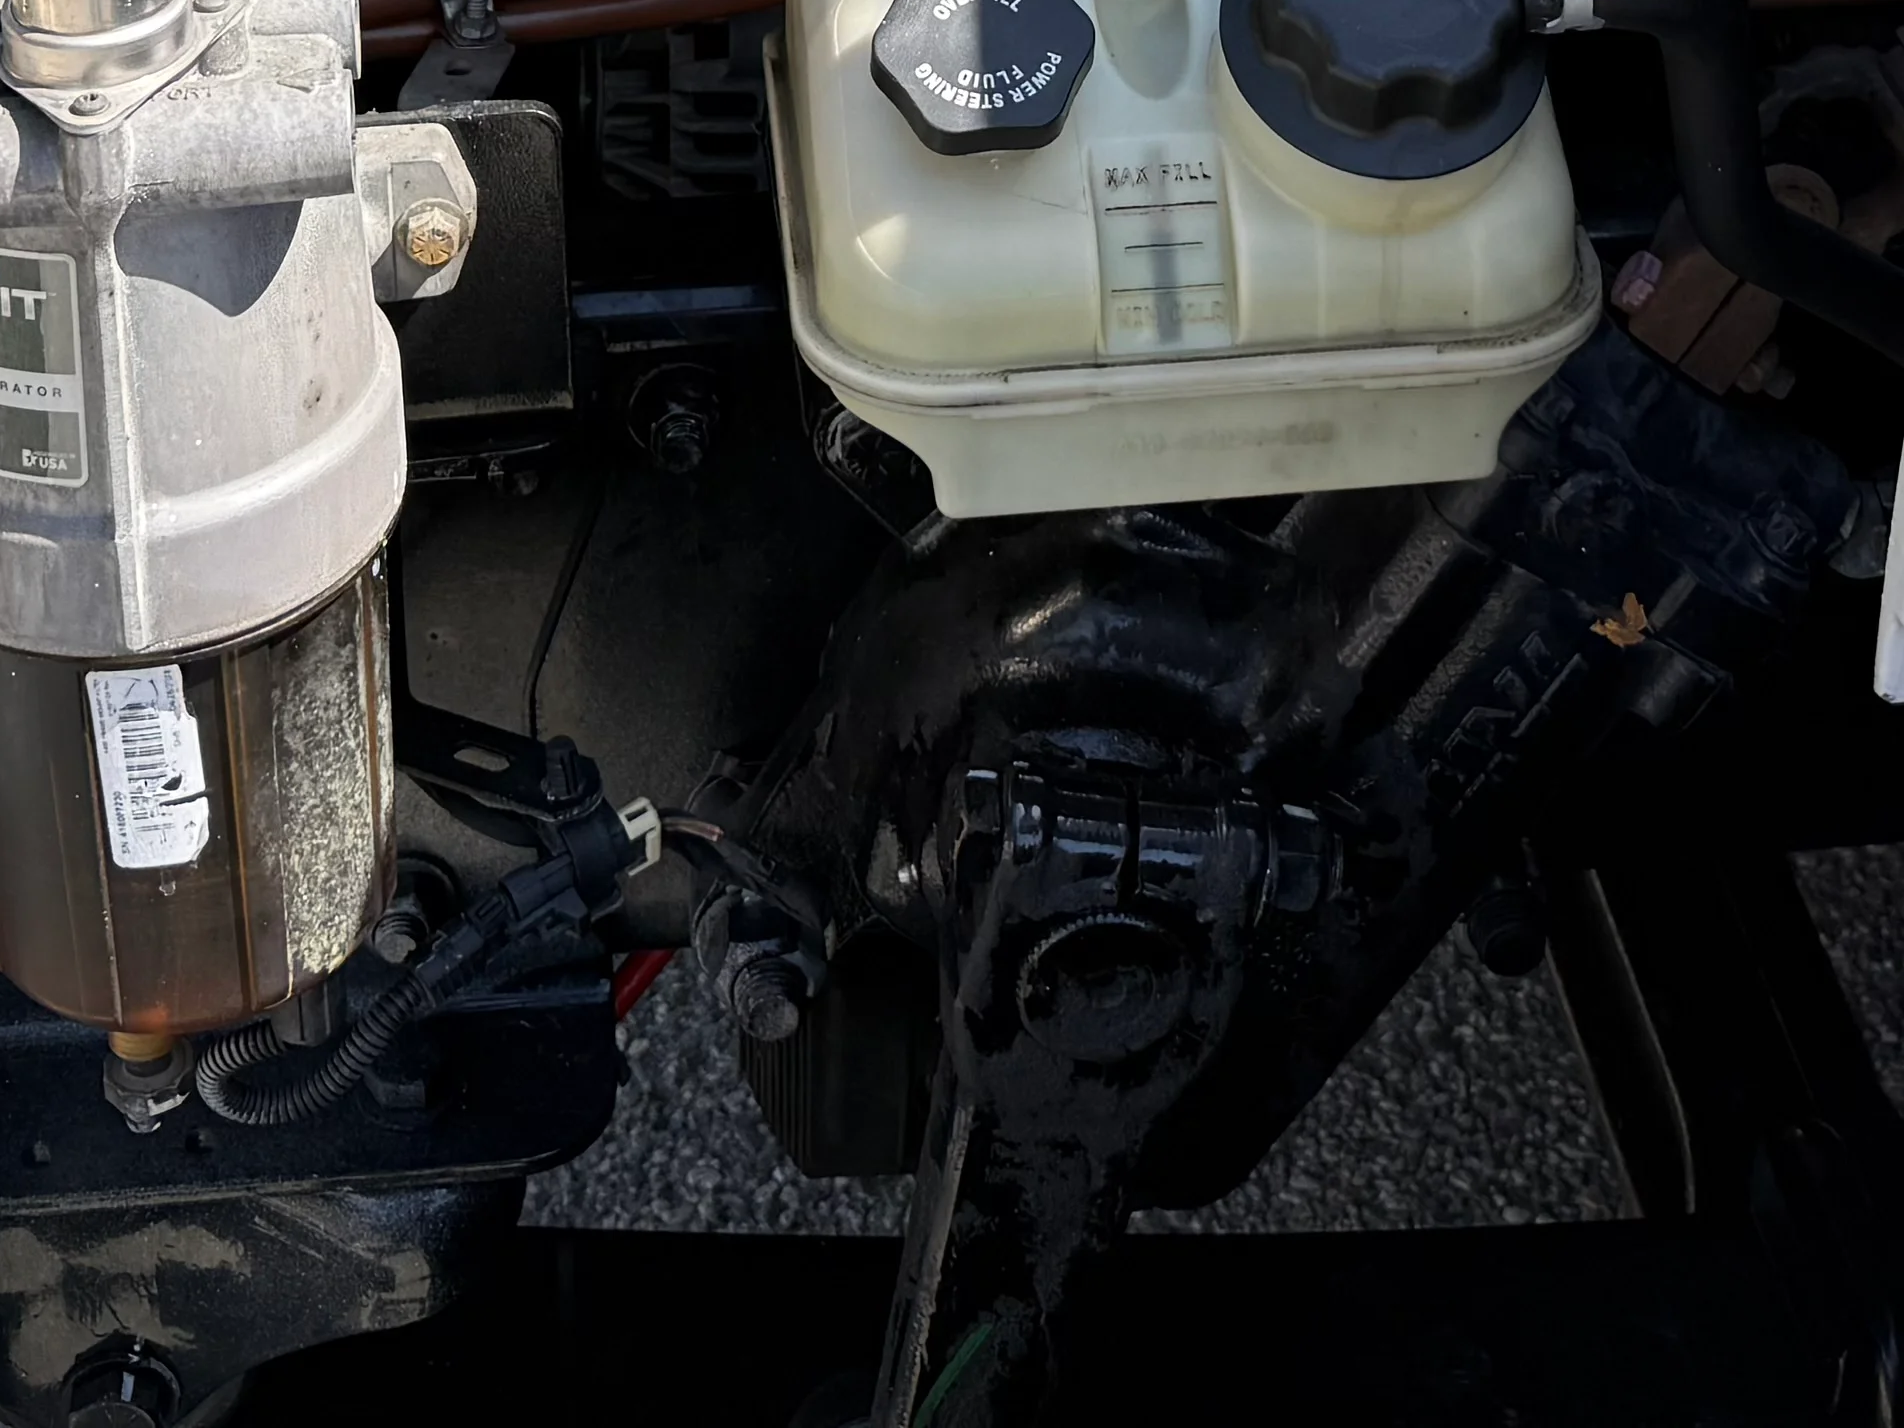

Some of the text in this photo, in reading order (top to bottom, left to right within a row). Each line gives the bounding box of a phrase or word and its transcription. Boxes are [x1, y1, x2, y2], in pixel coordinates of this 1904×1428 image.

[914, 51, 1062, 110] POWER STEERING
[957, 64, 1025, 90] FLUID
[1104, 160, 1212, 190] MAX FILL
[38, 456, 68, 471] USA
